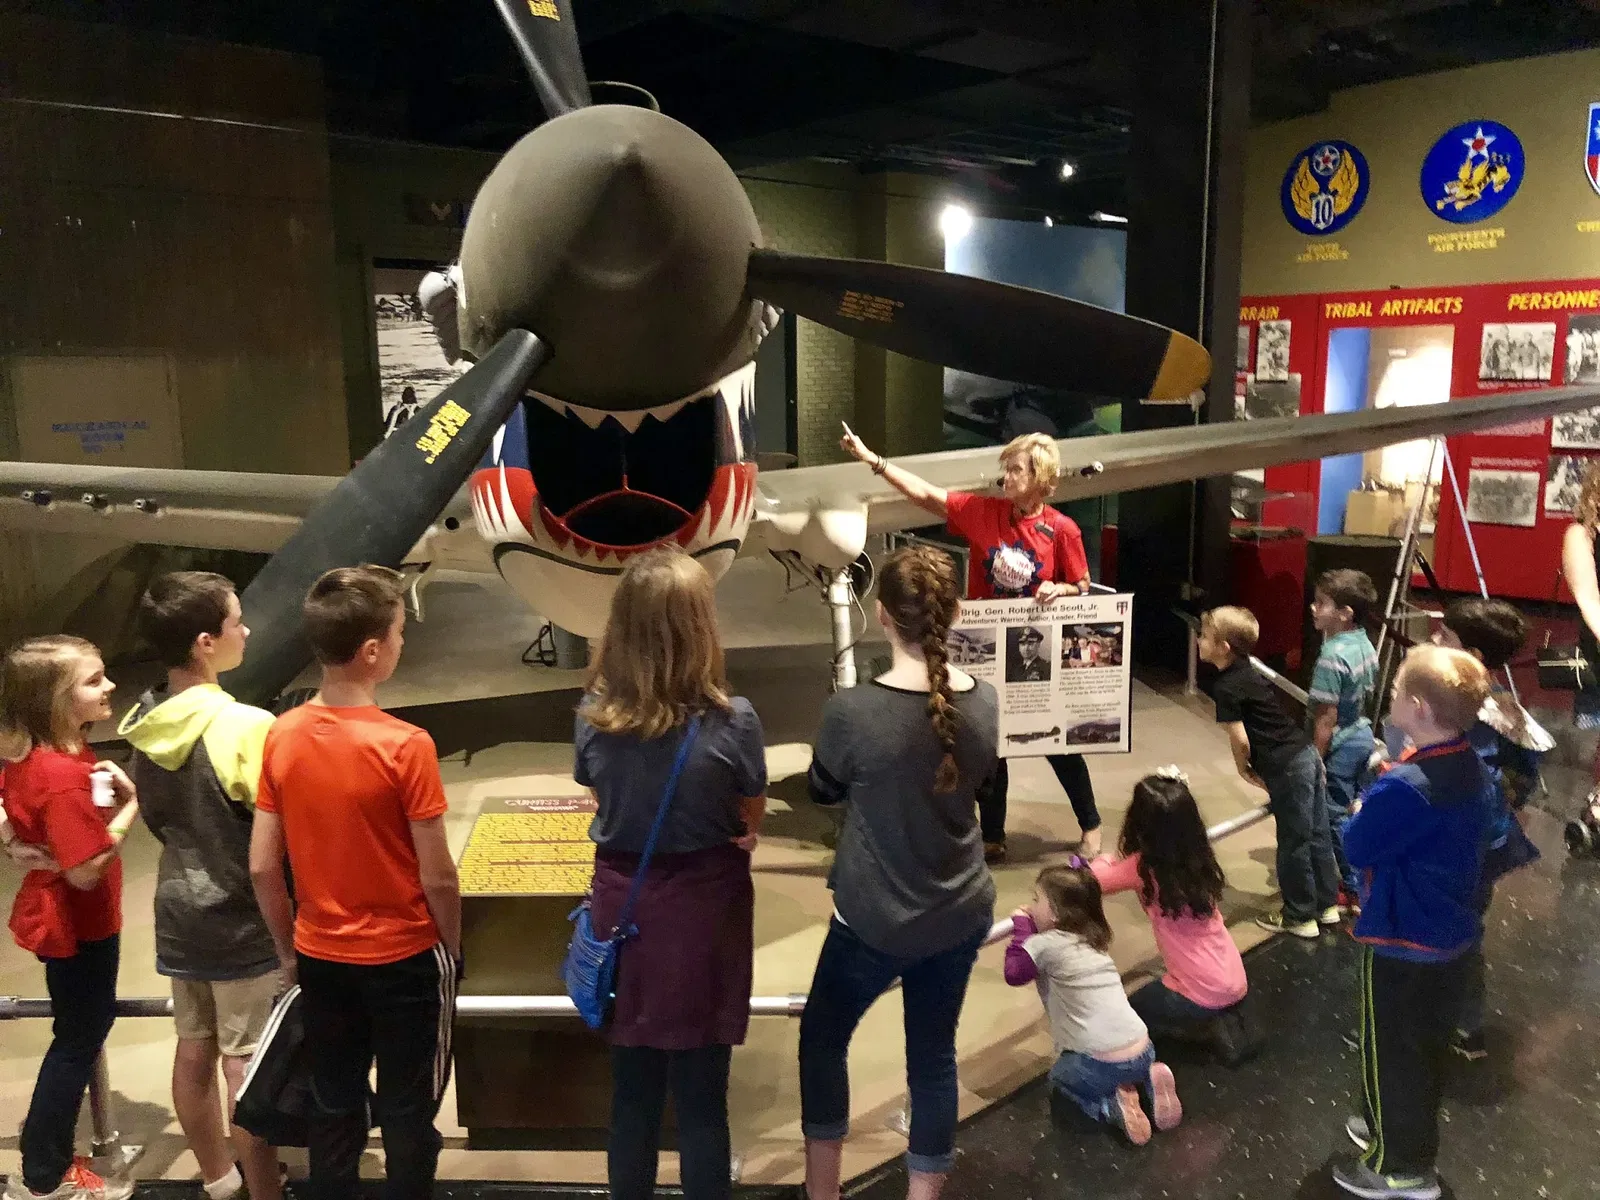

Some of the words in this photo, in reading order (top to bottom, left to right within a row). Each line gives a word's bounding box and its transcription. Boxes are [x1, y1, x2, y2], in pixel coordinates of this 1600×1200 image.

[1315, 199, 1332, 224] 10
[1434, 242, 1455, 253] AIR
[1457, 238, 1497, 251] FORCE
[1325, 301, 1373, 319] TRIBAL
[1380, 297, 1463, 316] ARTIFACTS
[961, 609, 981, 617] Brig.
[985, 607, 1006, 616] Gen.
[1009, 605, 1039, 614] Robert
[1060, 603, 1086, 612] Scott,
[1088, 603, 1099, 611] Jr.
